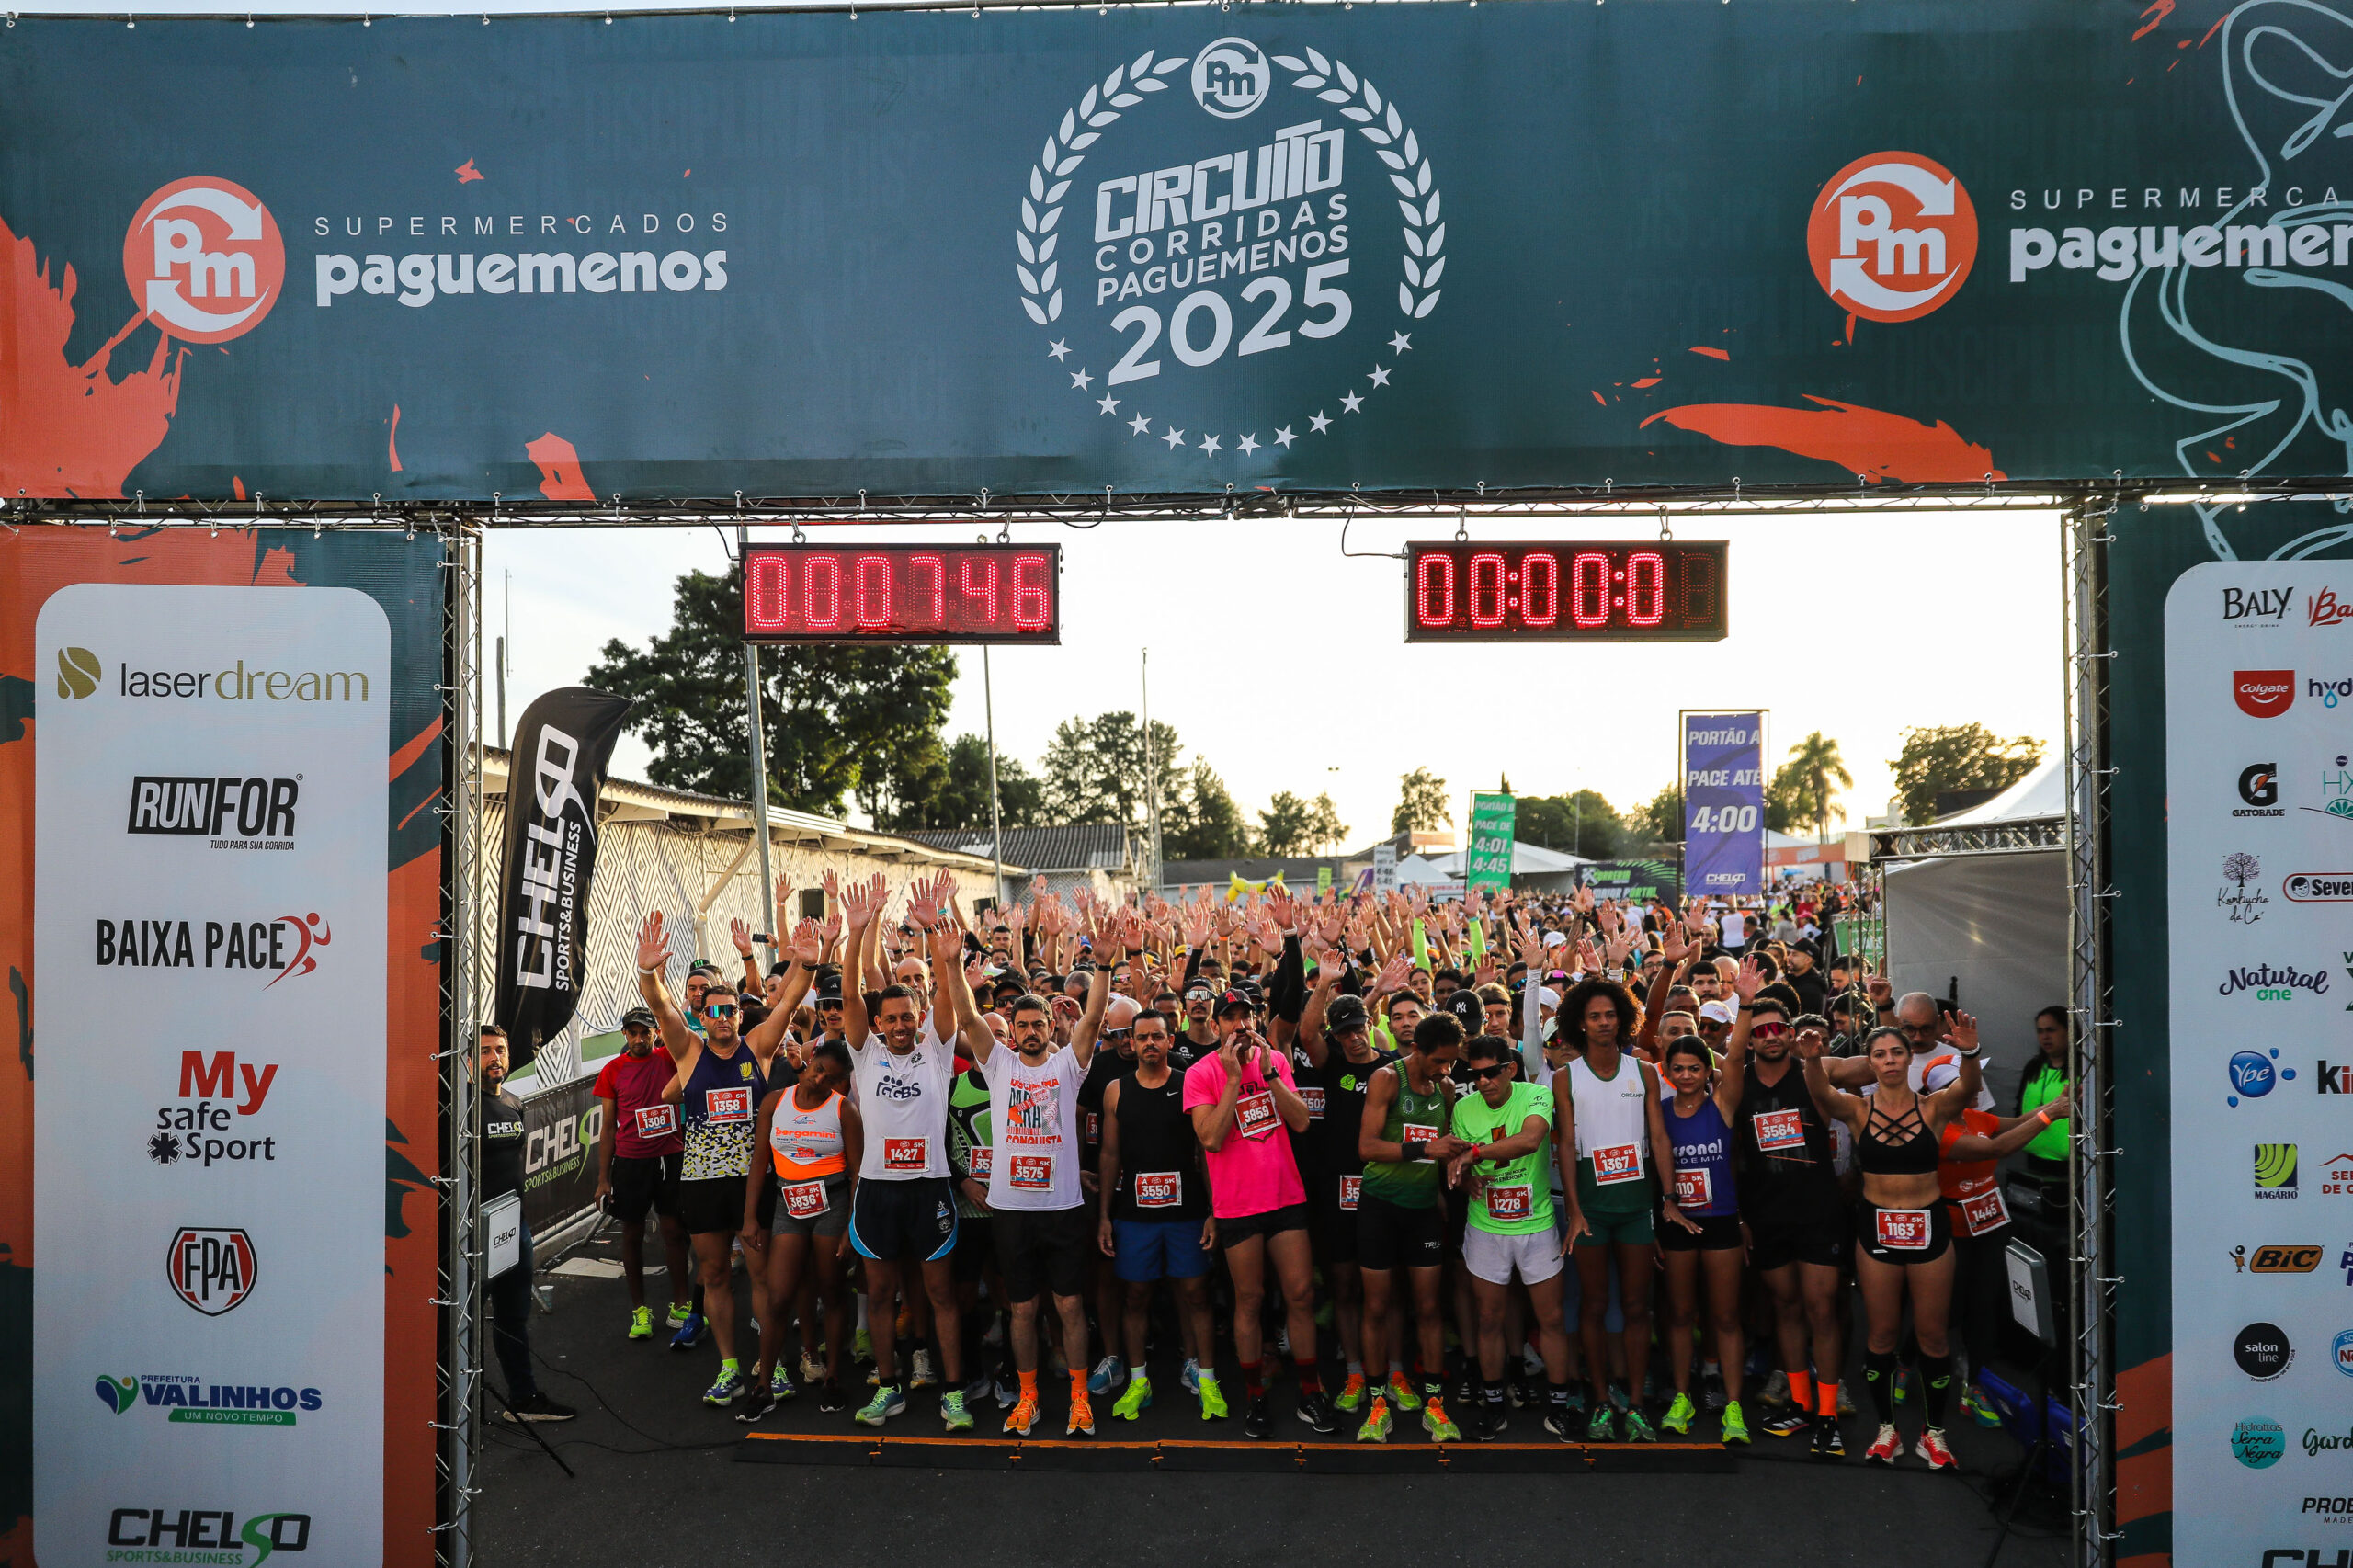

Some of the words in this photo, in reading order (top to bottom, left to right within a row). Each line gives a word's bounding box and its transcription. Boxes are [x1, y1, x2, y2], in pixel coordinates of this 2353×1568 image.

[1094, 119, 1345, 244] CIRCUITO
[314, 212, 730, 237] SUPERMERCADOS
[1095, 193, 1347, 273] CORRIDAS
[1097, 224, 1348, 306] PAGUEMENOS
[315, 249, 730, 308] paguemenos
[1108, 258, 1352, 386] 2025
[2222, 586, 2294, 619] BALY
[120, 660, 369, 702] laserdream
[2239, 683, 2290, 696] Colgate
[1688, 727, 1746, 746] PORTÃO
[1688, 770, 1729, 787] PACE
[1691, 805, 1758, 833] 4:00
[2232, 809, 2286, 817] GATORADE
[210, 840, 229, 850] TUDO
[230, 840, 248, 850] PARA
[249, 841, 263, 850] SUA
[264, 841, 295, 851] CORRIDA
[1474, 836, 1506, 854] 4:01
[1472, 857, 1507, 874] 4:45
[2312, 878, 2353, 896] Seve
[555, 821, 582, 992] SPORTS&BUSINESS
[97, 918, 195, 968] BAIXA
[205, 921, 287, 970] PACE
[2219, 963, 2330, 995] Natural
[2256, 989, 2292, 1002] one
[178, 1051, 279, 1116] My
[714, 1099, 741, 1113] 1358
[1243, 1106, 1269, 1123] 3859
[156, 1101, 231, 1131] safe
[643, 1115, 666, 1129] 1308
[775, 1126, 836, 1140] bergamini
[1762, 1122, 1796, 1139] 3564
[1006, 1134, 1063, 1145] CONQUISTA
[185, 1132, 276, 1167] Sport
[890, 1148, 918, 1161] 1427
[1602, 1155, 1630, 1172] 1367
[1016, 1166, 1044, 1179] 3575
[1141, 1185, 1171, 1197] 3550
[2323, 1184, 2342, 1195] DE
[789, 1194, 816, 1208] 3836
[1494, 1198, 1521, 1210] 1278
[1884, 1214, 1892, 1222] A
[1972, 1202, 1998, 1222] 1445
[1886, 1223, 1915, 1236] 1163
[184, 1237, 241, 1301] FPA
[2245, 1342, 2279, 1353] salon
[2258, 1352, 2279, 1363] line
[141, 1374, 201, 1385] PREFEITURA
[142, 1383, 323, 1412] VALINHOS
[183, 1411, 202, 1421] UM
[205, 1411, 240, 1422] NOVO
[241, 1413, 283, 1423] TEMPO
[2231, 1431, 2275, 1446] Serra
[2234, 1445, 2284, 1463] Negra
[108, 1508, 311, 1566] CHELSO
[106, 1550, 244, 1566] SPORTS&BUSINESS
